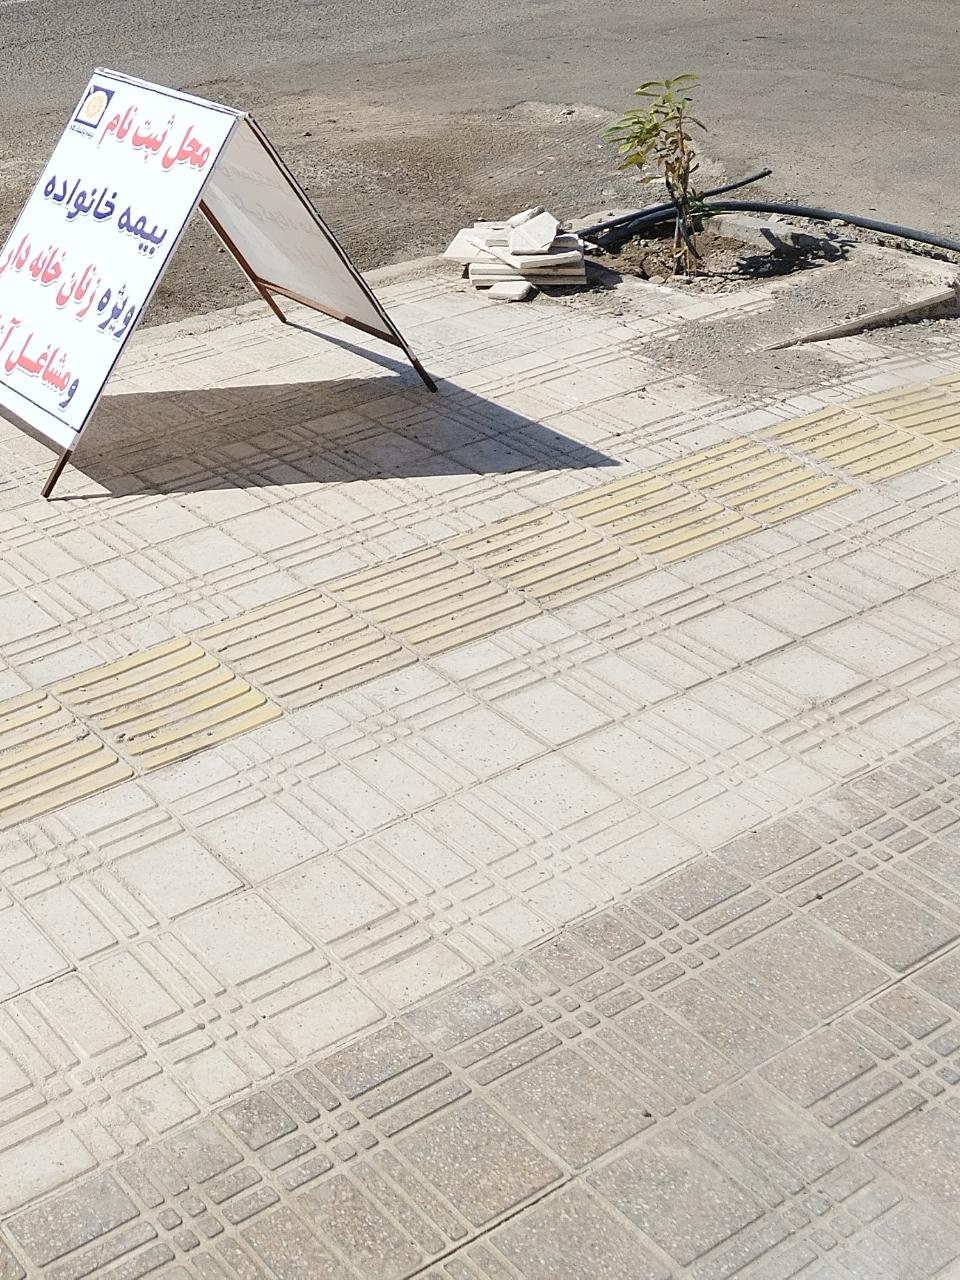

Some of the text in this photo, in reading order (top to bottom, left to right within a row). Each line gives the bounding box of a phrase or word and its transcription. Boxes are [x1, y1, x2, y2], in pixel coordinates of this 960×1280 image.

[98, 106, 210, 169] محل ثبت نام
[43, 175, 168, 255] بیمه خانواده
[29, 244, 67, 283] خانه
[56, 264, 101, 318] زنان
[98, 284, 136, 338] ویژه
